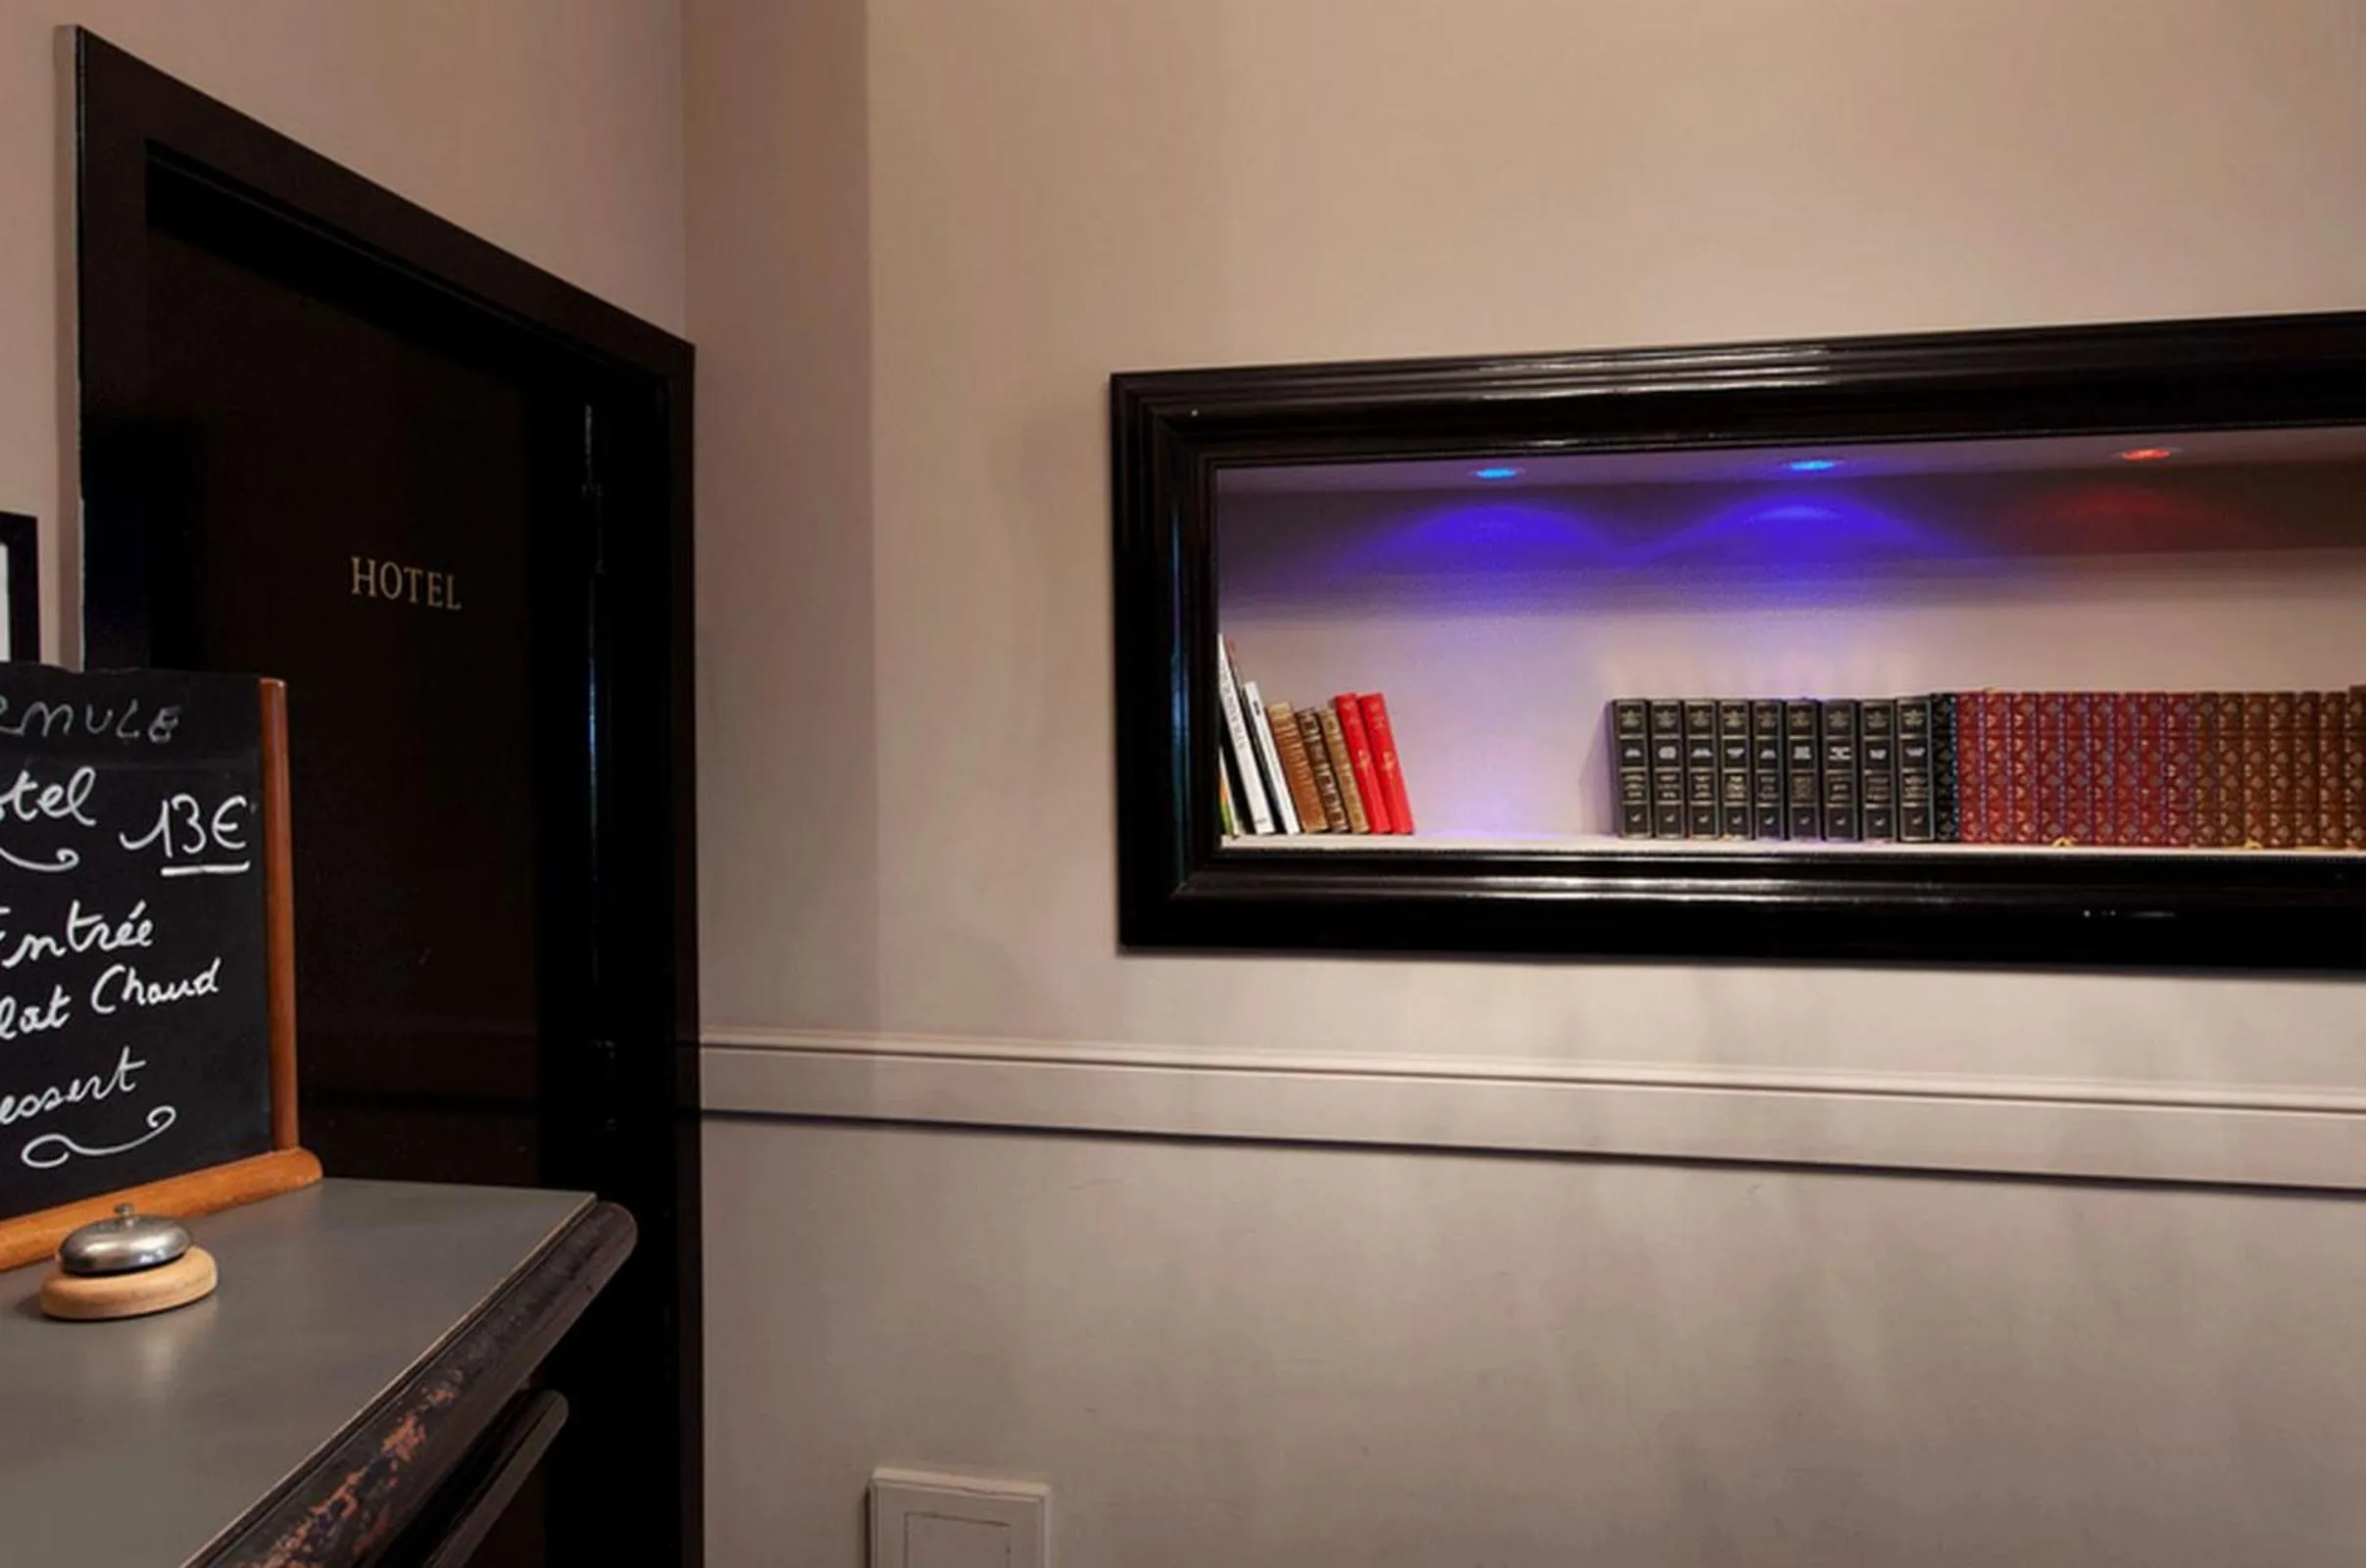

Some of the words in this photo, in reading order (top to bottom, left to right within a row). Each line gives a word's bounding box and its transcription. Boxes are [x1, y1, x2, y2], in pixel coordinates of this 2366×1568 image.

[350, 555, 462, 612] HOTEL
[0, 765, 97, 827] tel
[119, 793, 248, 858] 13€
[90, 956, 222, 1014] Chaud
